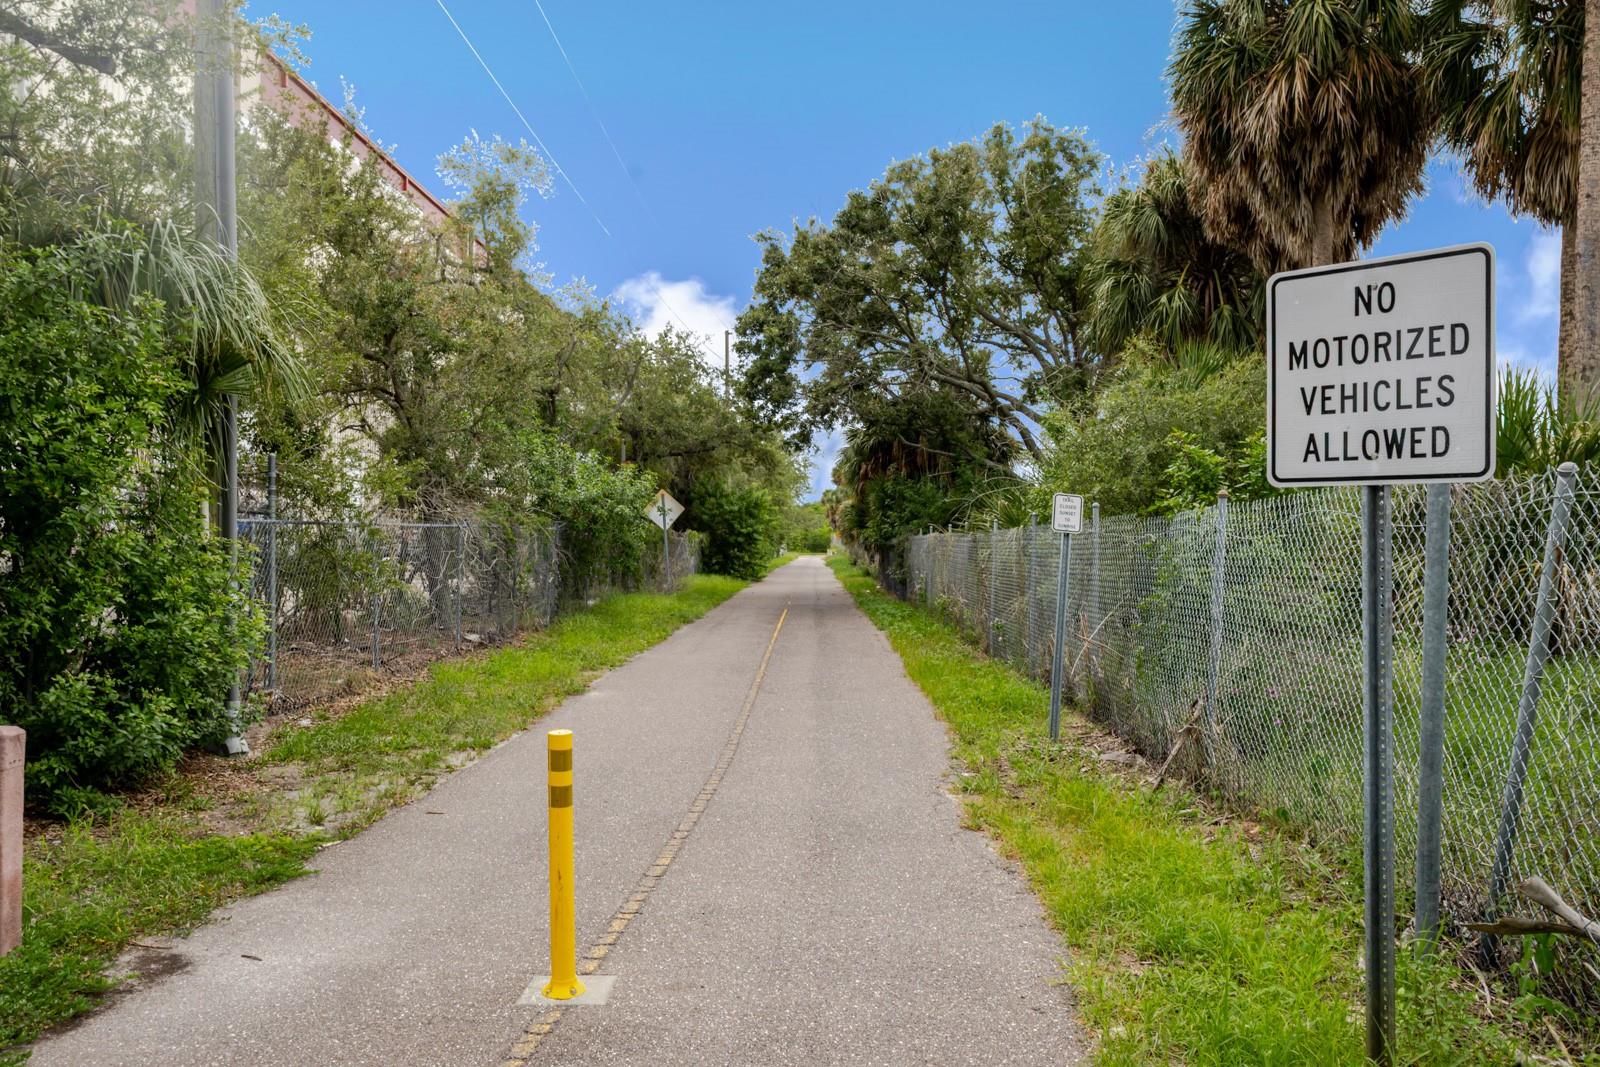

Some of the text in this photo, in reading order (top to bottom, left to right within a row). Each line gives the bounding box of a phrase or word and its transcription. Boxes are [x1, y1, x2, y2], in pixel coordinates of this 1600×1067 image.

[1354, 282, 1396, 317] NO
[1288, 322, 1470, 371] MOTORIZED
[1300, 374, 1455, 416] VEHICLES
[1302, 425, 1450, 463] ALLOWED
